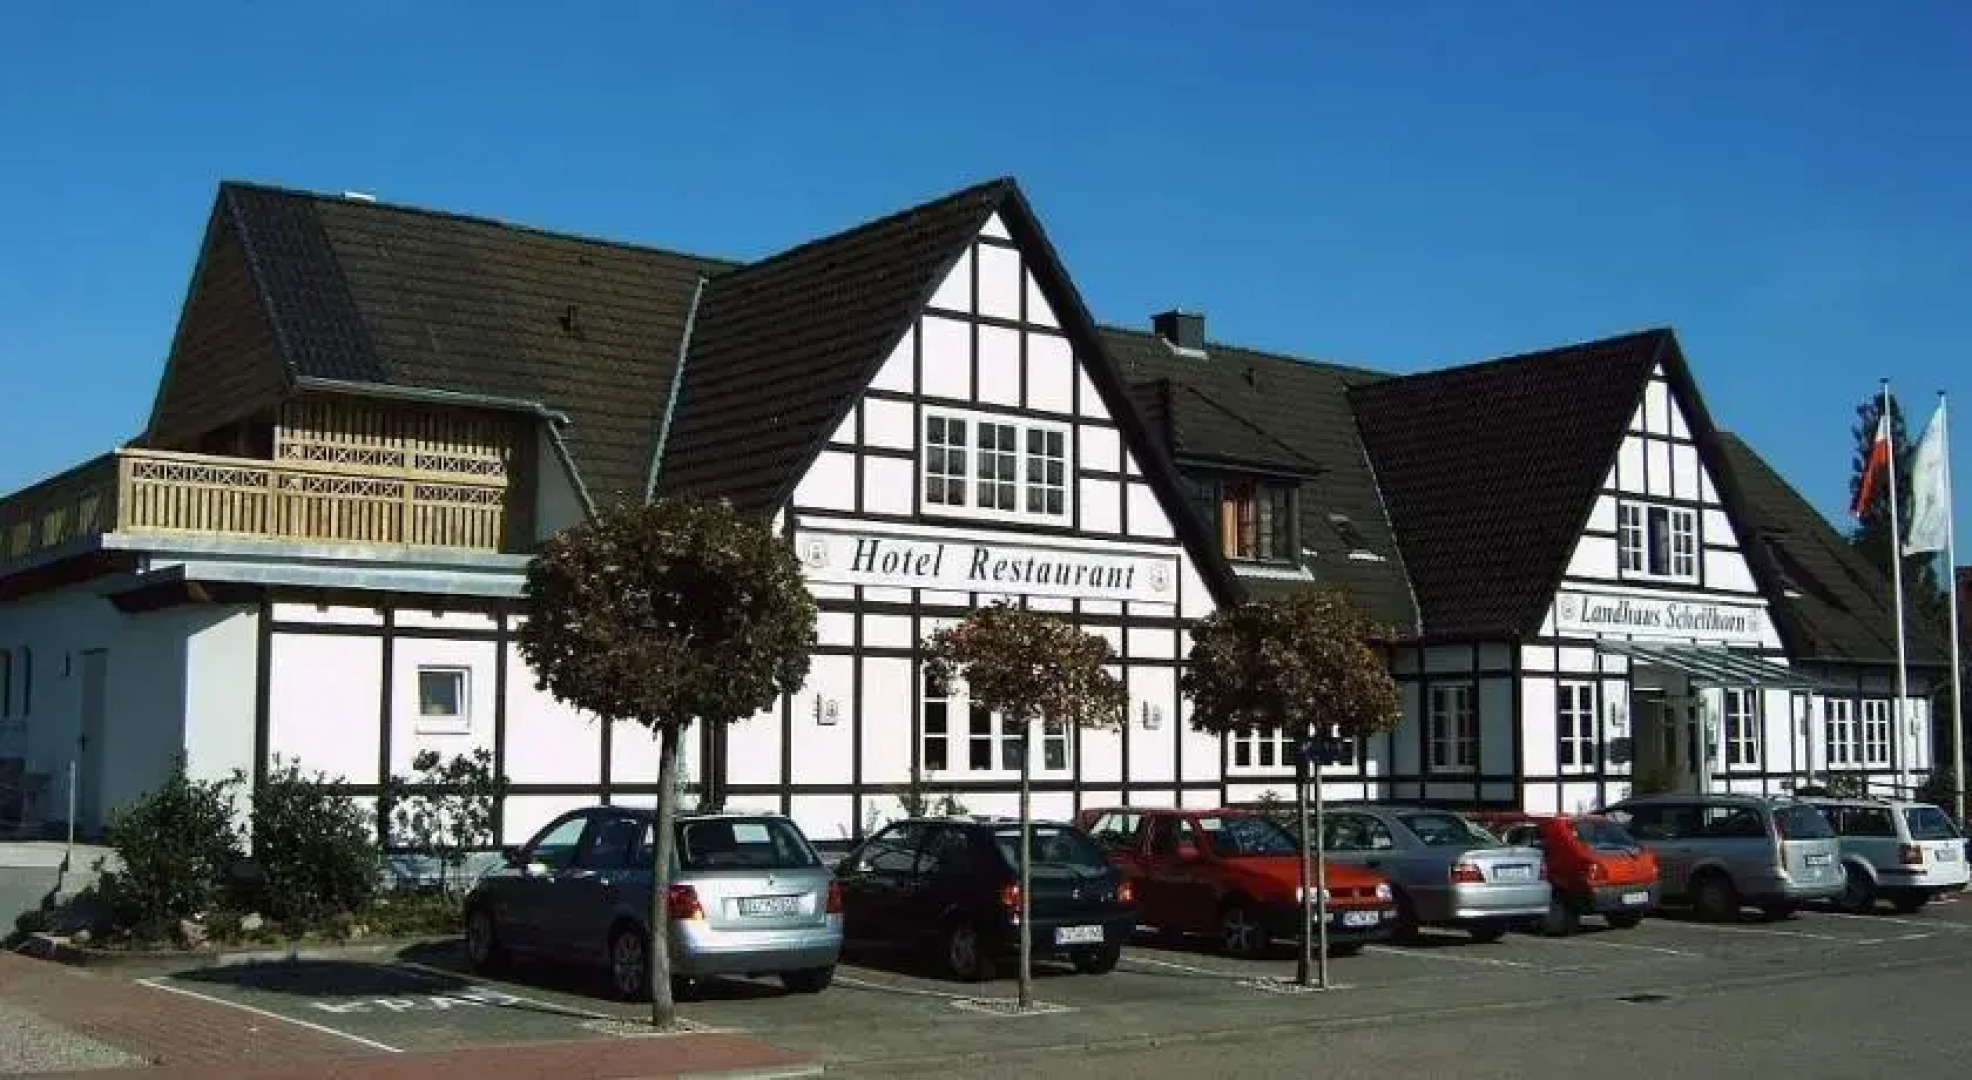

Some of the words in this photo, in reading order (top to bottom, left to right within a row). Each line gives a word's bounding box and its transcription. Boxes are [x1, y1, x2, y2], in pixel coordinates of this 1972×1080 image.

[851, 539, 944, 577] Hotel
[968, 546, 1135, 589] Restaurant
[1582, 597, 1661, 627] Landhaus
